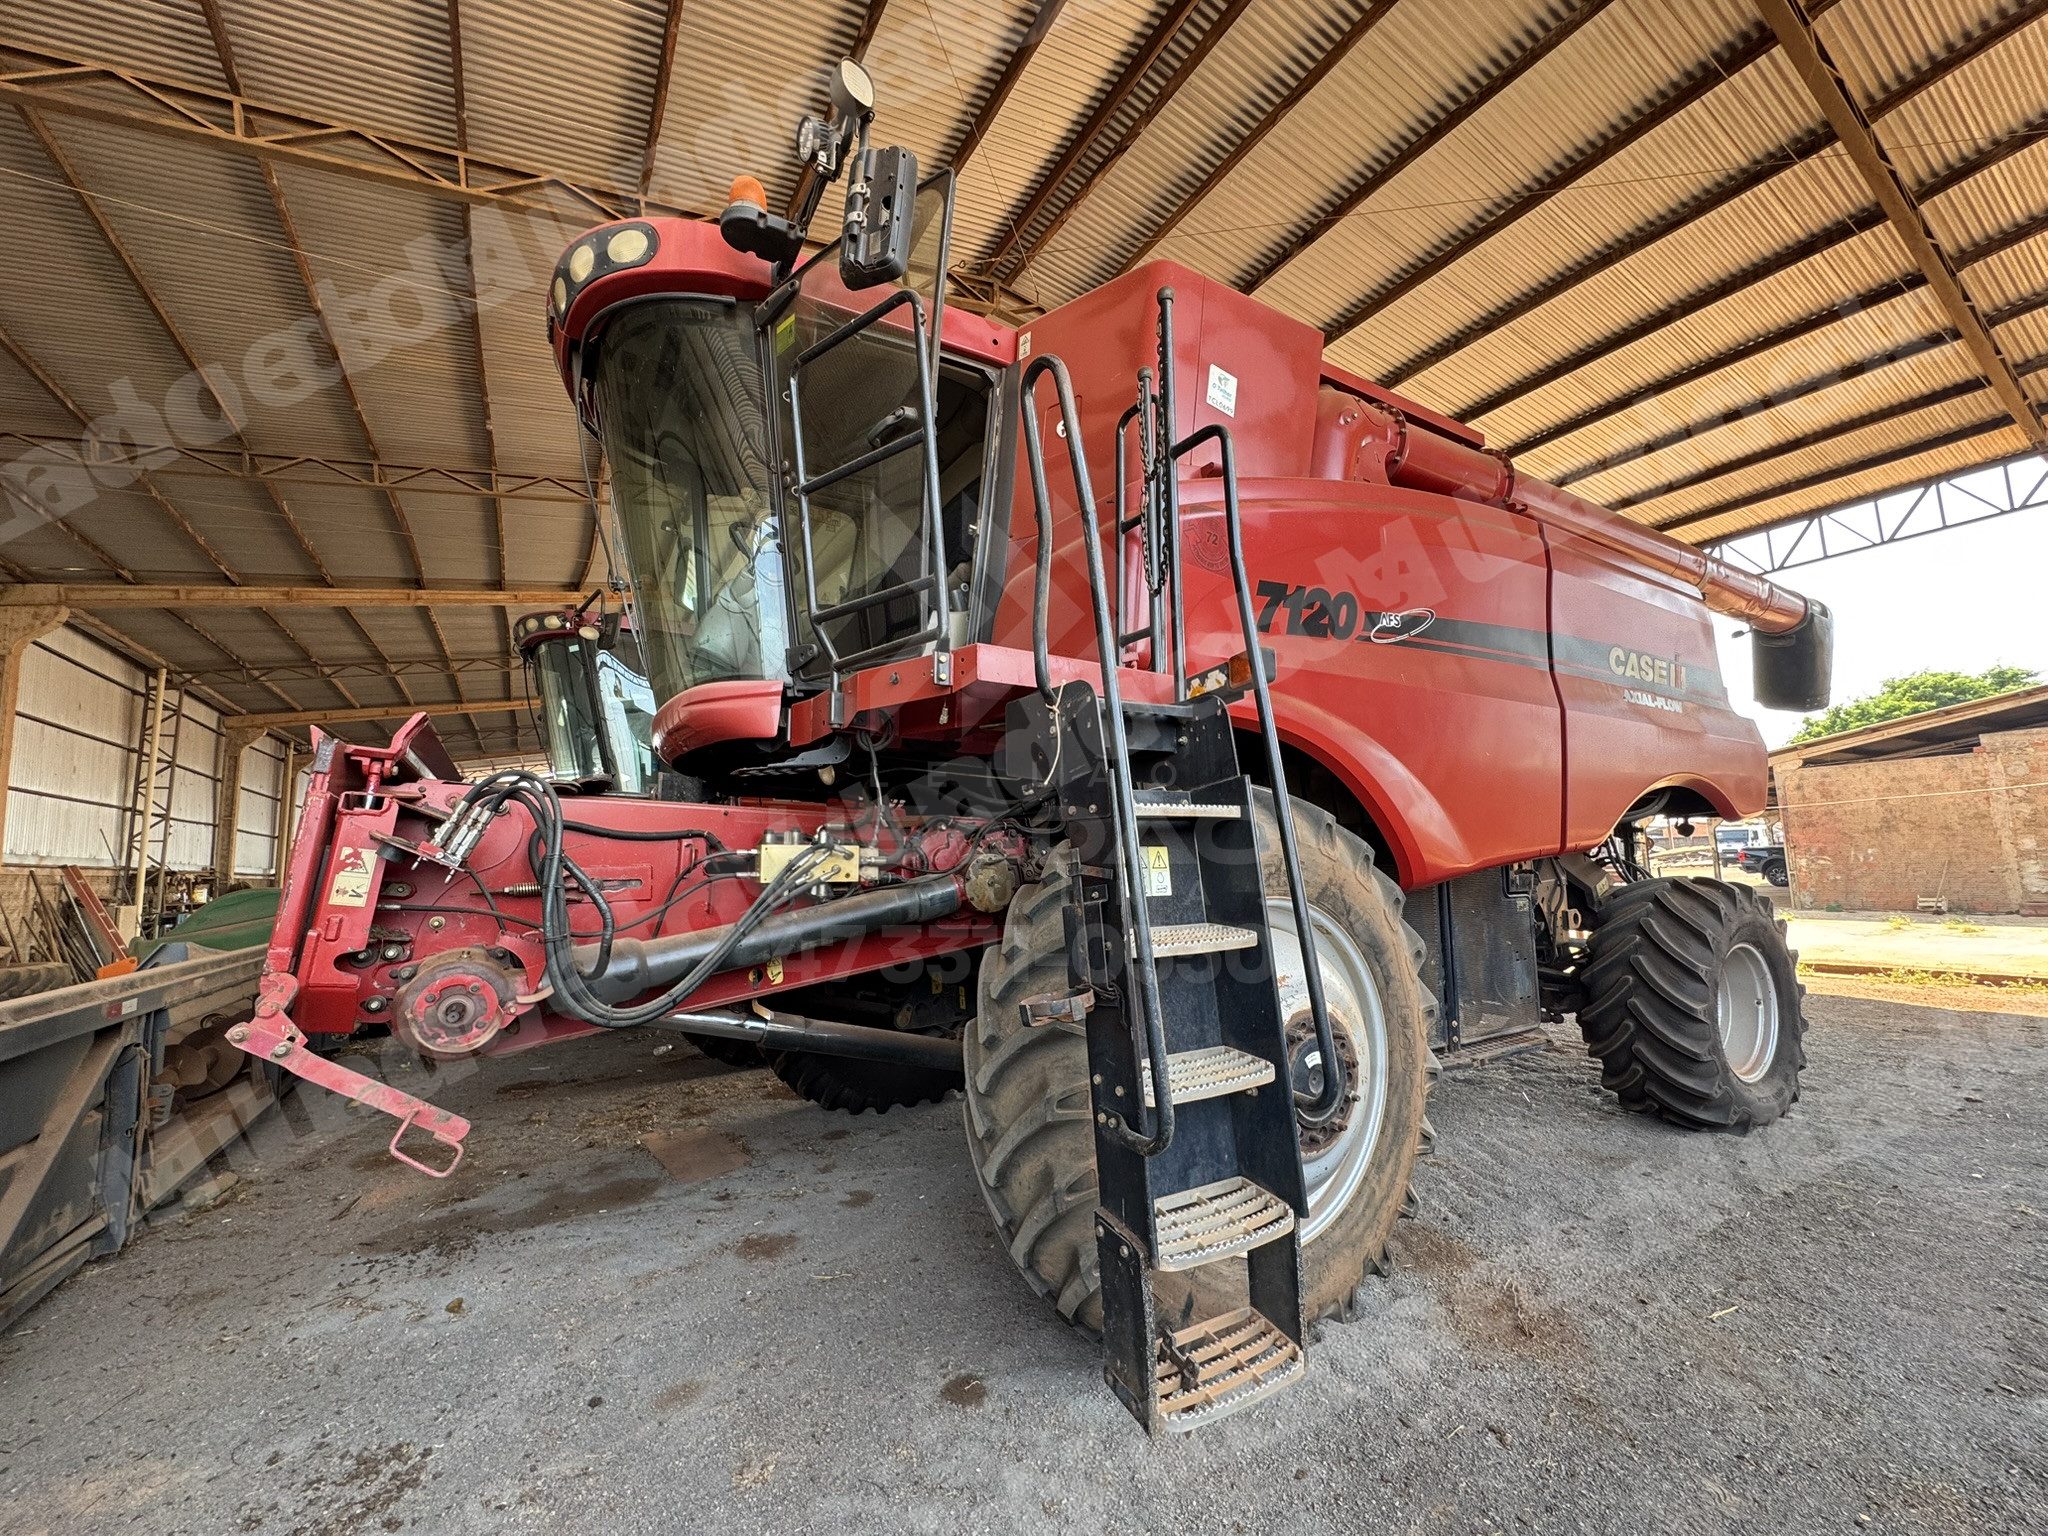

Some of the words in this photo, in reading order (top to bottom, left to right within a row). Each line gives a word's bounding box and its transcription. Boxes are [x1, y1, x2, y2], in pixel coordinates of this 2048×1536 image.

[1205, 531, 1219, 546] 72
[1255, 579, 1359, 640] 7120
[1380, 612, 1402, 628] AFS
[1609, 646, 1668, 686] CASE
